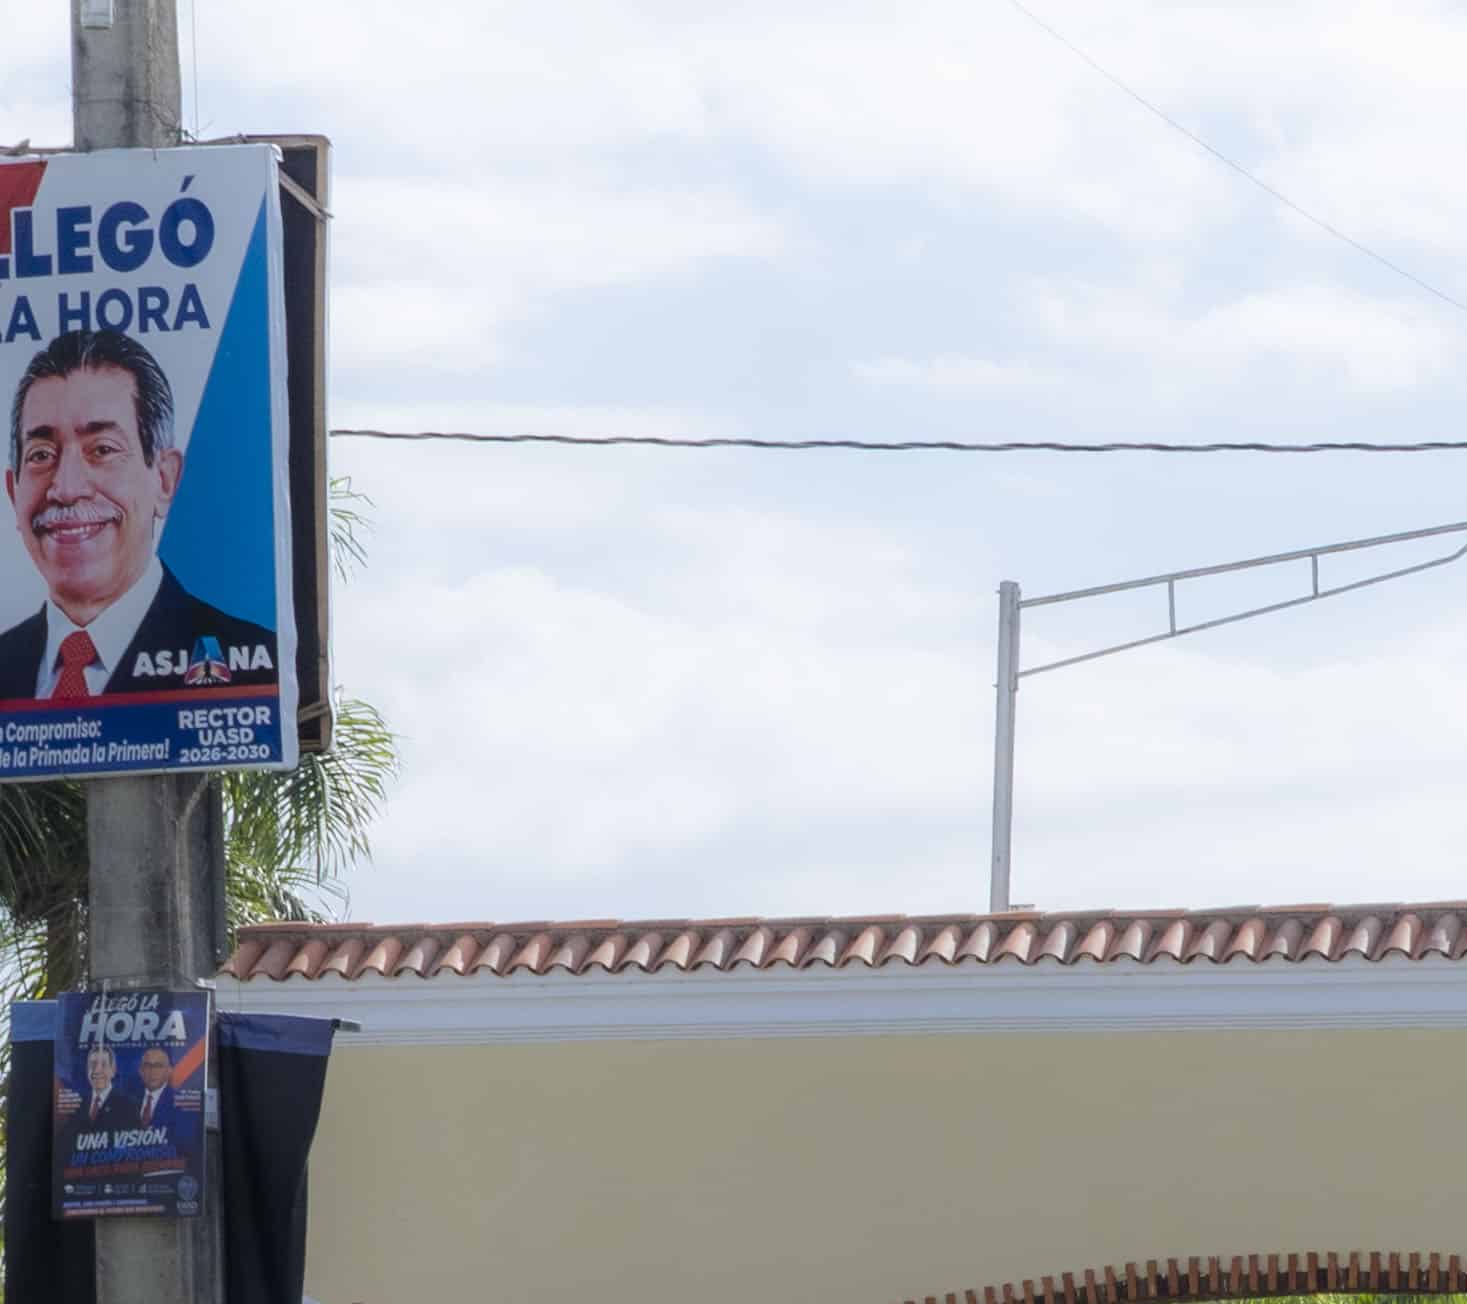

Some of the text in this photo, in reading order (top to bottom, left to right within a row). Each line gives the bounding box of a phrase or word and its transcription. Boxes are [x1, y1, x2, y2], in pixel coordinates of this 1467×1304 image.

[0, 175, 215, 280] LEGÓ
[0, 284, 210, 344] A HORA
[6, 717, 101, 745] Compromiso:
[178, 706, 271, 729] RECTOR
[199, 728, 254, 745] UASD
[14, 750, 28, 767] la
[29, 746, 88, 766] Primada
[90, 745, 107, 763] la
[109, 738, 170, 763] Primera!
[179, 745, 269, 763] 2026-2030
[79, 1009, 187, 1042] HORA
[77, 1126, 168, 1150] UNA VISIÓN.
